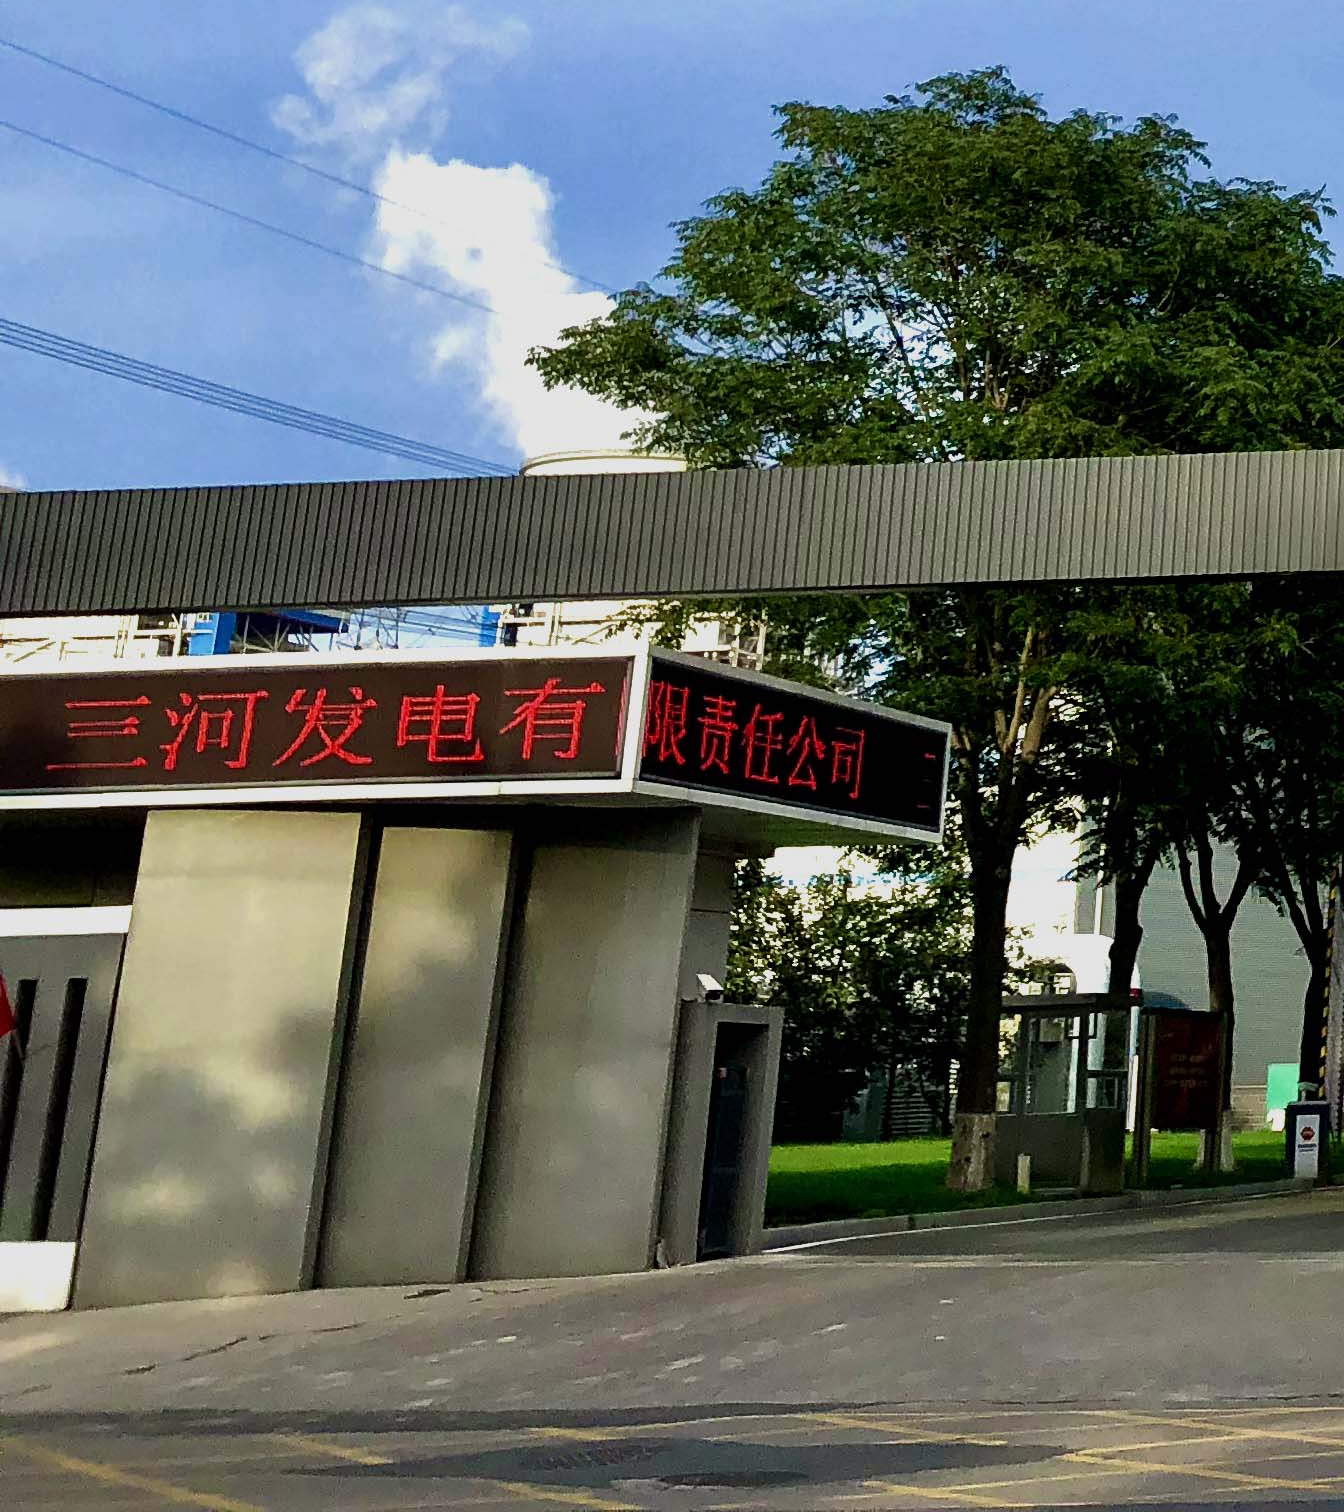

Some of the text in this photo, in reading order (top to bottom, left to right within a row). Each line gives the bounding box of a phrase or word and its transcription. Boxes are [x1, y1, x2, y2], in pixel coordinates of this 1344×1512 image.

[45, 677, 607, 772] 三河发电有
[643, 680, 865, 799] 限责任公司
